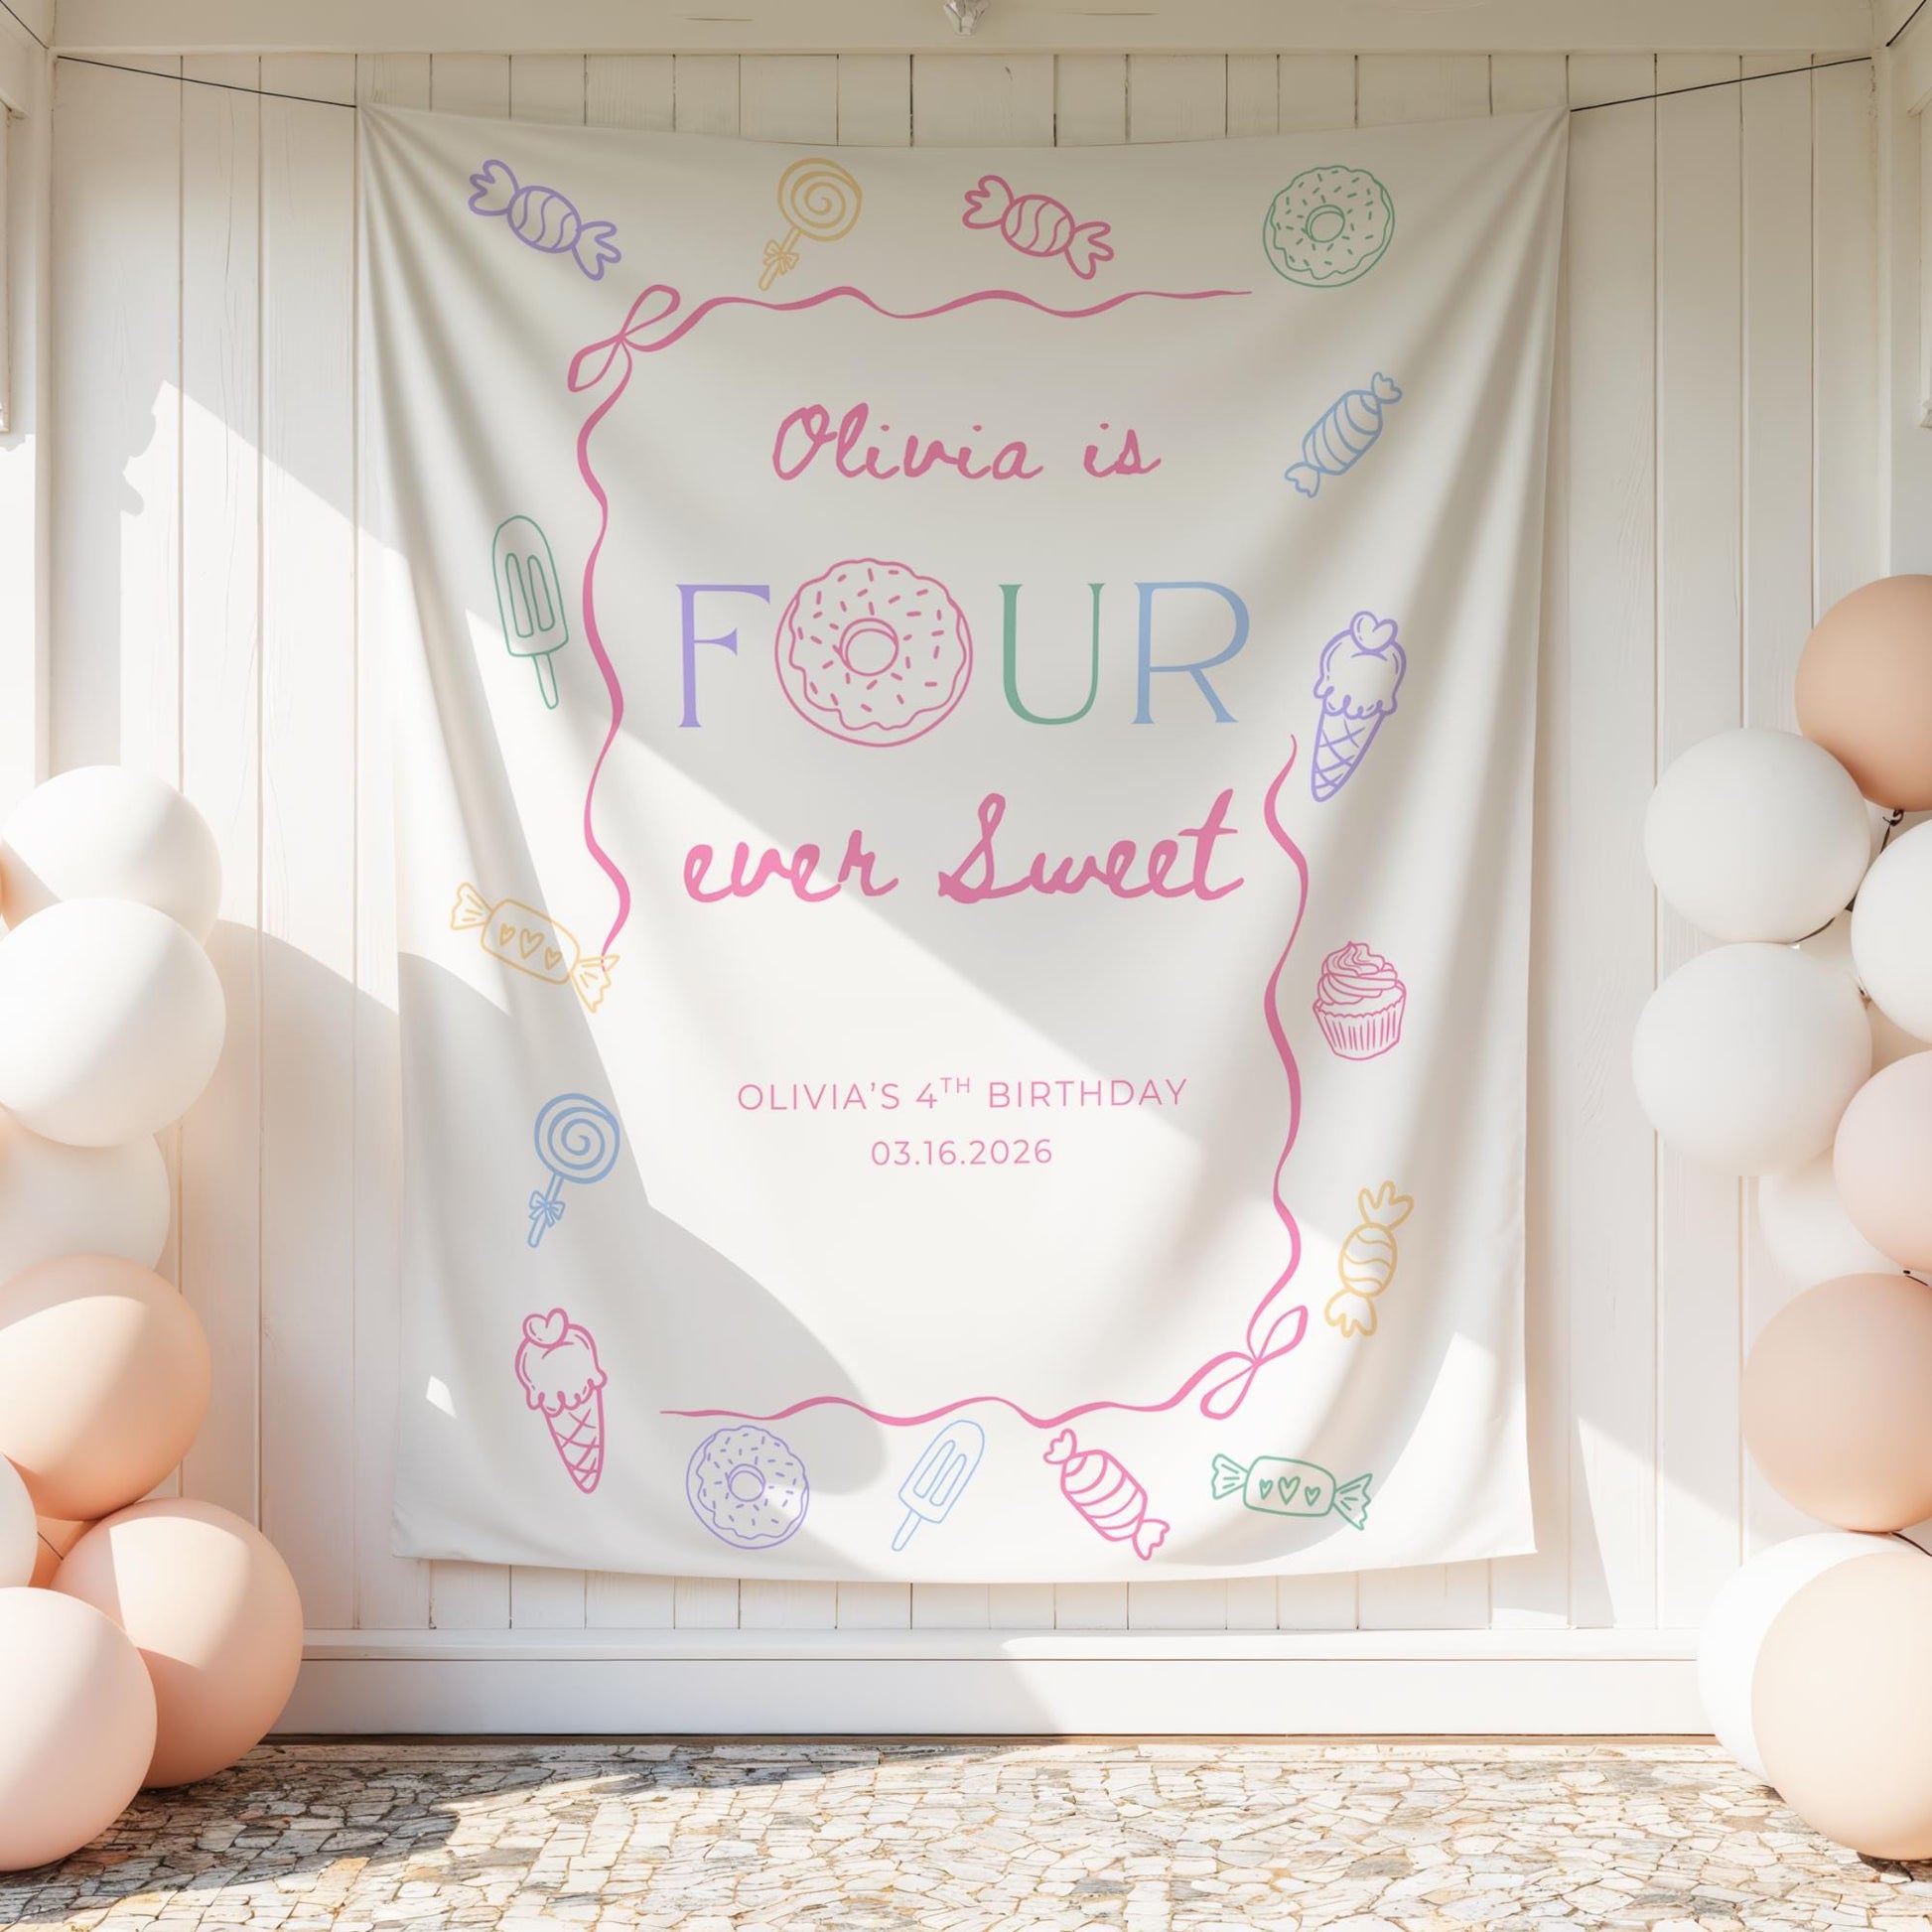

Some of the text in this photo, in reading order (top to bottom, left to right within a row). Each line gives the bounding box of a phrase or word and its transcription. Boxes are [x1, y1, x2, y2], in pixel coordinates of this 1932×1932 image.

[771, 401, 1162, 482] Olivia is
[683, 788, 1245, 904] ever Sweet
[737, 1077, 1188, 1111] OLIVIA’S 4TH BIRTHDAY
[870, 1139, 1052, 1167] 03.16.2026
